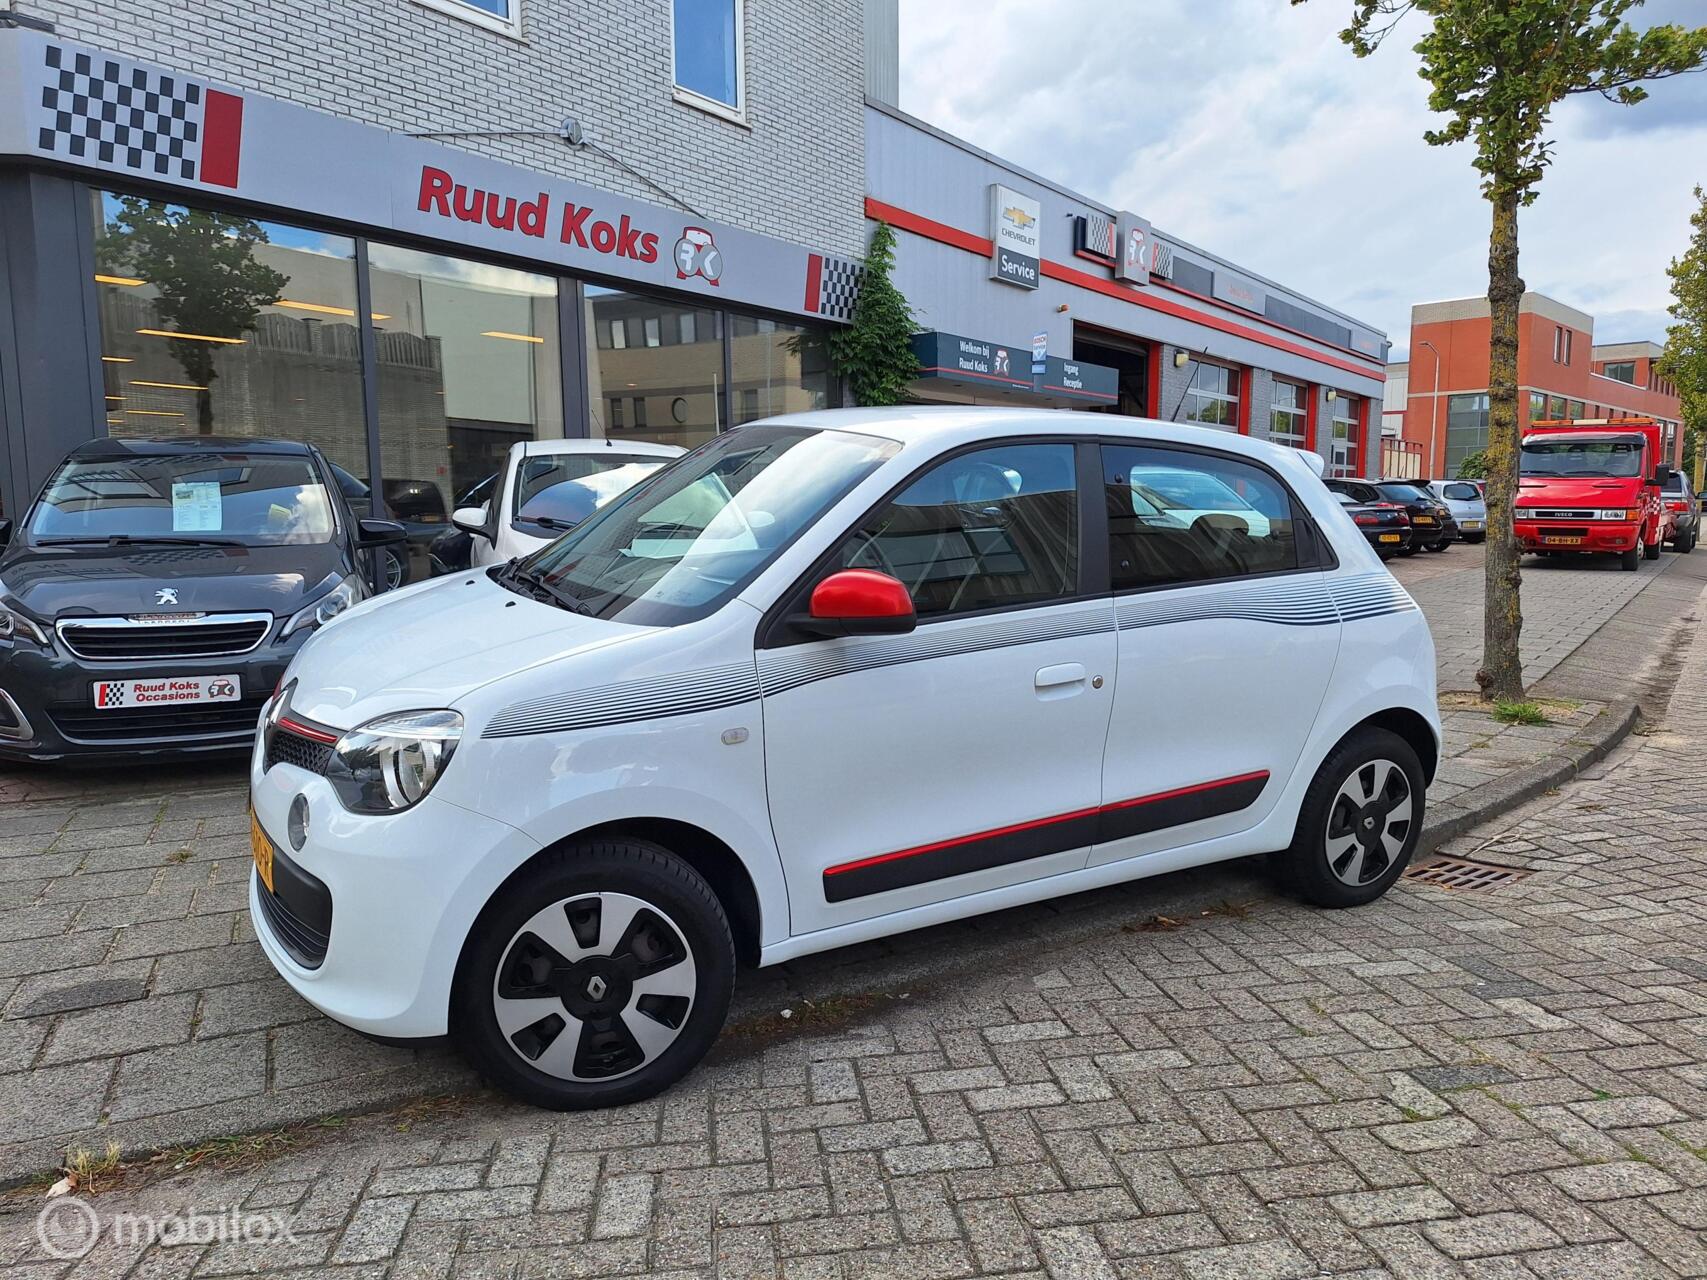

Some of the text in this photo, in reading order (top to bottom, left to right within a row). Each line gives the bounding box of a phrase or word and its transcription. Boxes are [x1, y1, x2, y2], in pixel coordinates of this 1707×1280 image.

[417, 166, 659, 264] Ruud Koks
[1002, 228, 1036, 246] CHEVROLET
[1001, 254, 1035, 280] Service
[959, 340, 982, 355] Welkom
[959, 357, 973, 370] Ruud
[974, 360, 988, 373] Koks
[1063, 362, 1079, 375] Ingang
[1063, 377, 1083, 390] Receptie
[134, 681, 200, 693] Ruud Koks
[136, 691, 200, 702] Occasions
